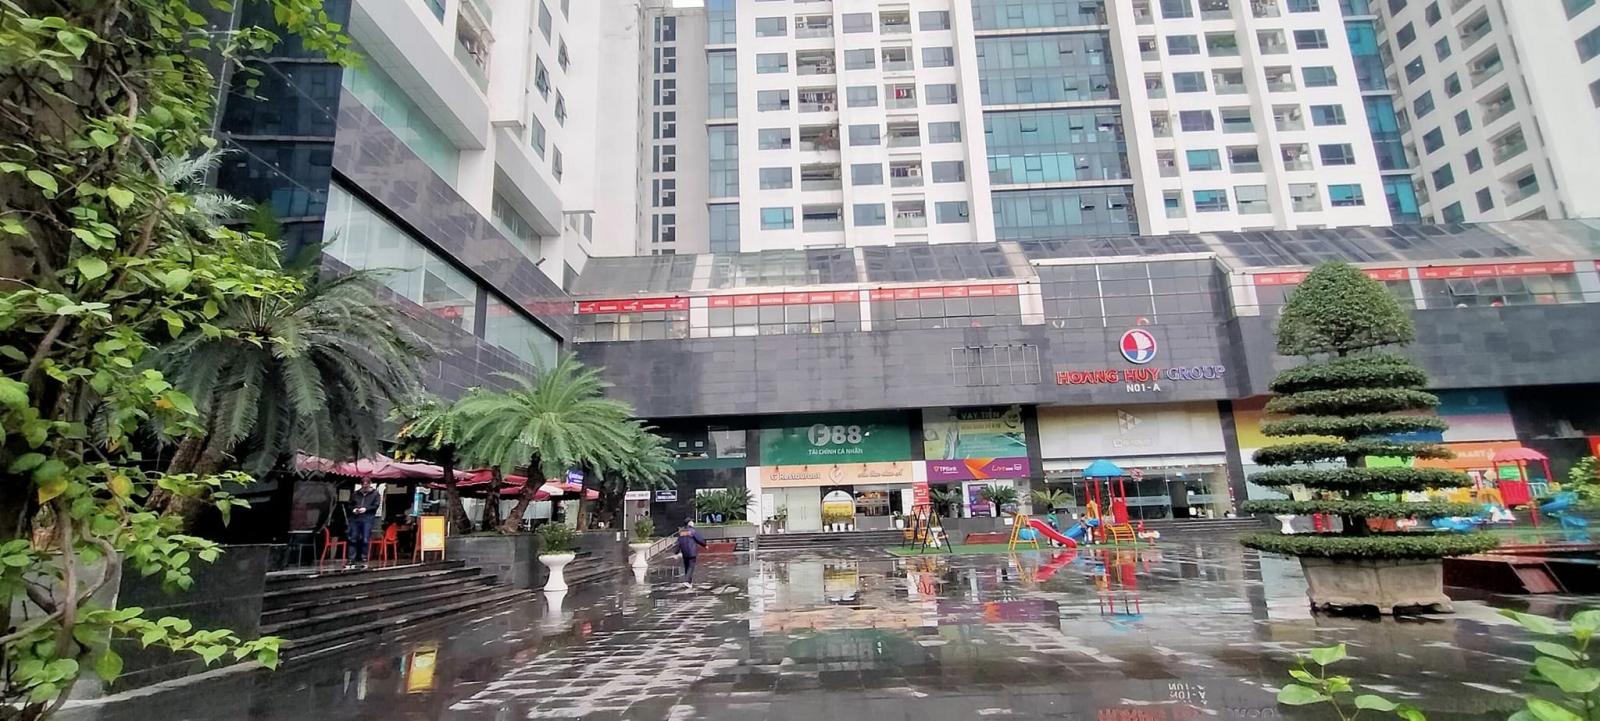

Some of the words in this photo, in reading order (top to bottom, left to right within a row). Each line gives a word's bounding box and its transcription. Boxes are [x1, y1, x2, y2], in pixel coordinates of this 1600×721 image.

[1056, 369, 1119, 385] HOANG
[1124, 367, 1160, 382] HUY
[1166, 365, 1226, 380] GROUP
[1126, 383, 1161, 392] N01-A
[808, 424, 862, 446] F88
